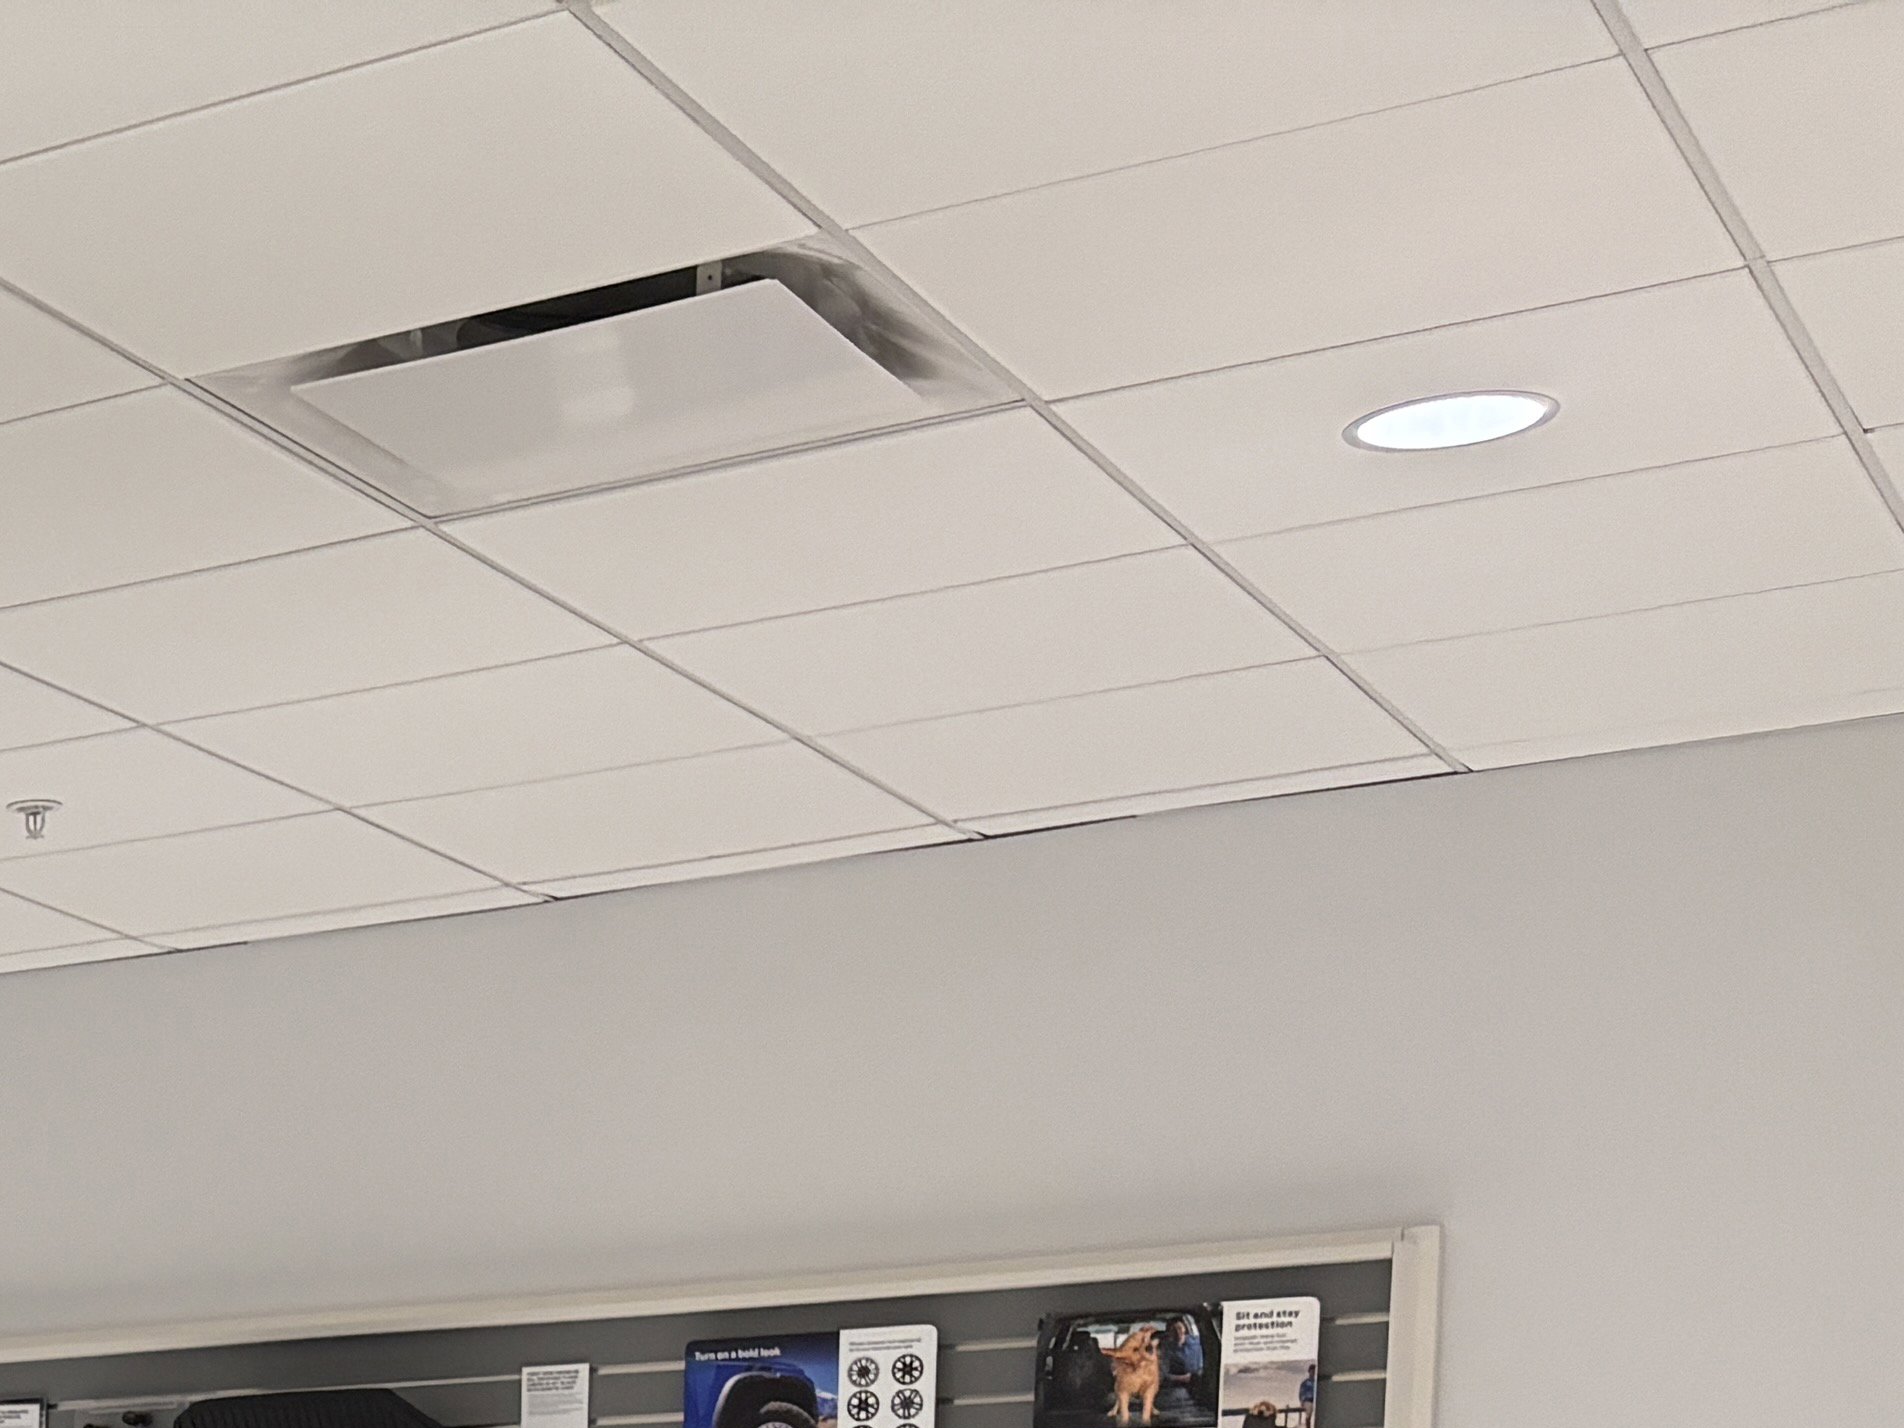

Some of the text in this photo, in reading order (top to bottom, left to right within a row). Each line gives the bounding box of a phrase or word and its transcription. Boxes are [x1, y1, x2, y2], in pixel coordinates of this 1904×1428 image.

[1236, 1309, 1301, 1320] Sit and stay
[1235, 1319, 1293, 1332] protection
[694, 1351, 716, 1361] Turn
[716, 1351, 730, 1361] on
[737, 1348, 759, 1359] bold
[759, 1346, 781, 1357] look
